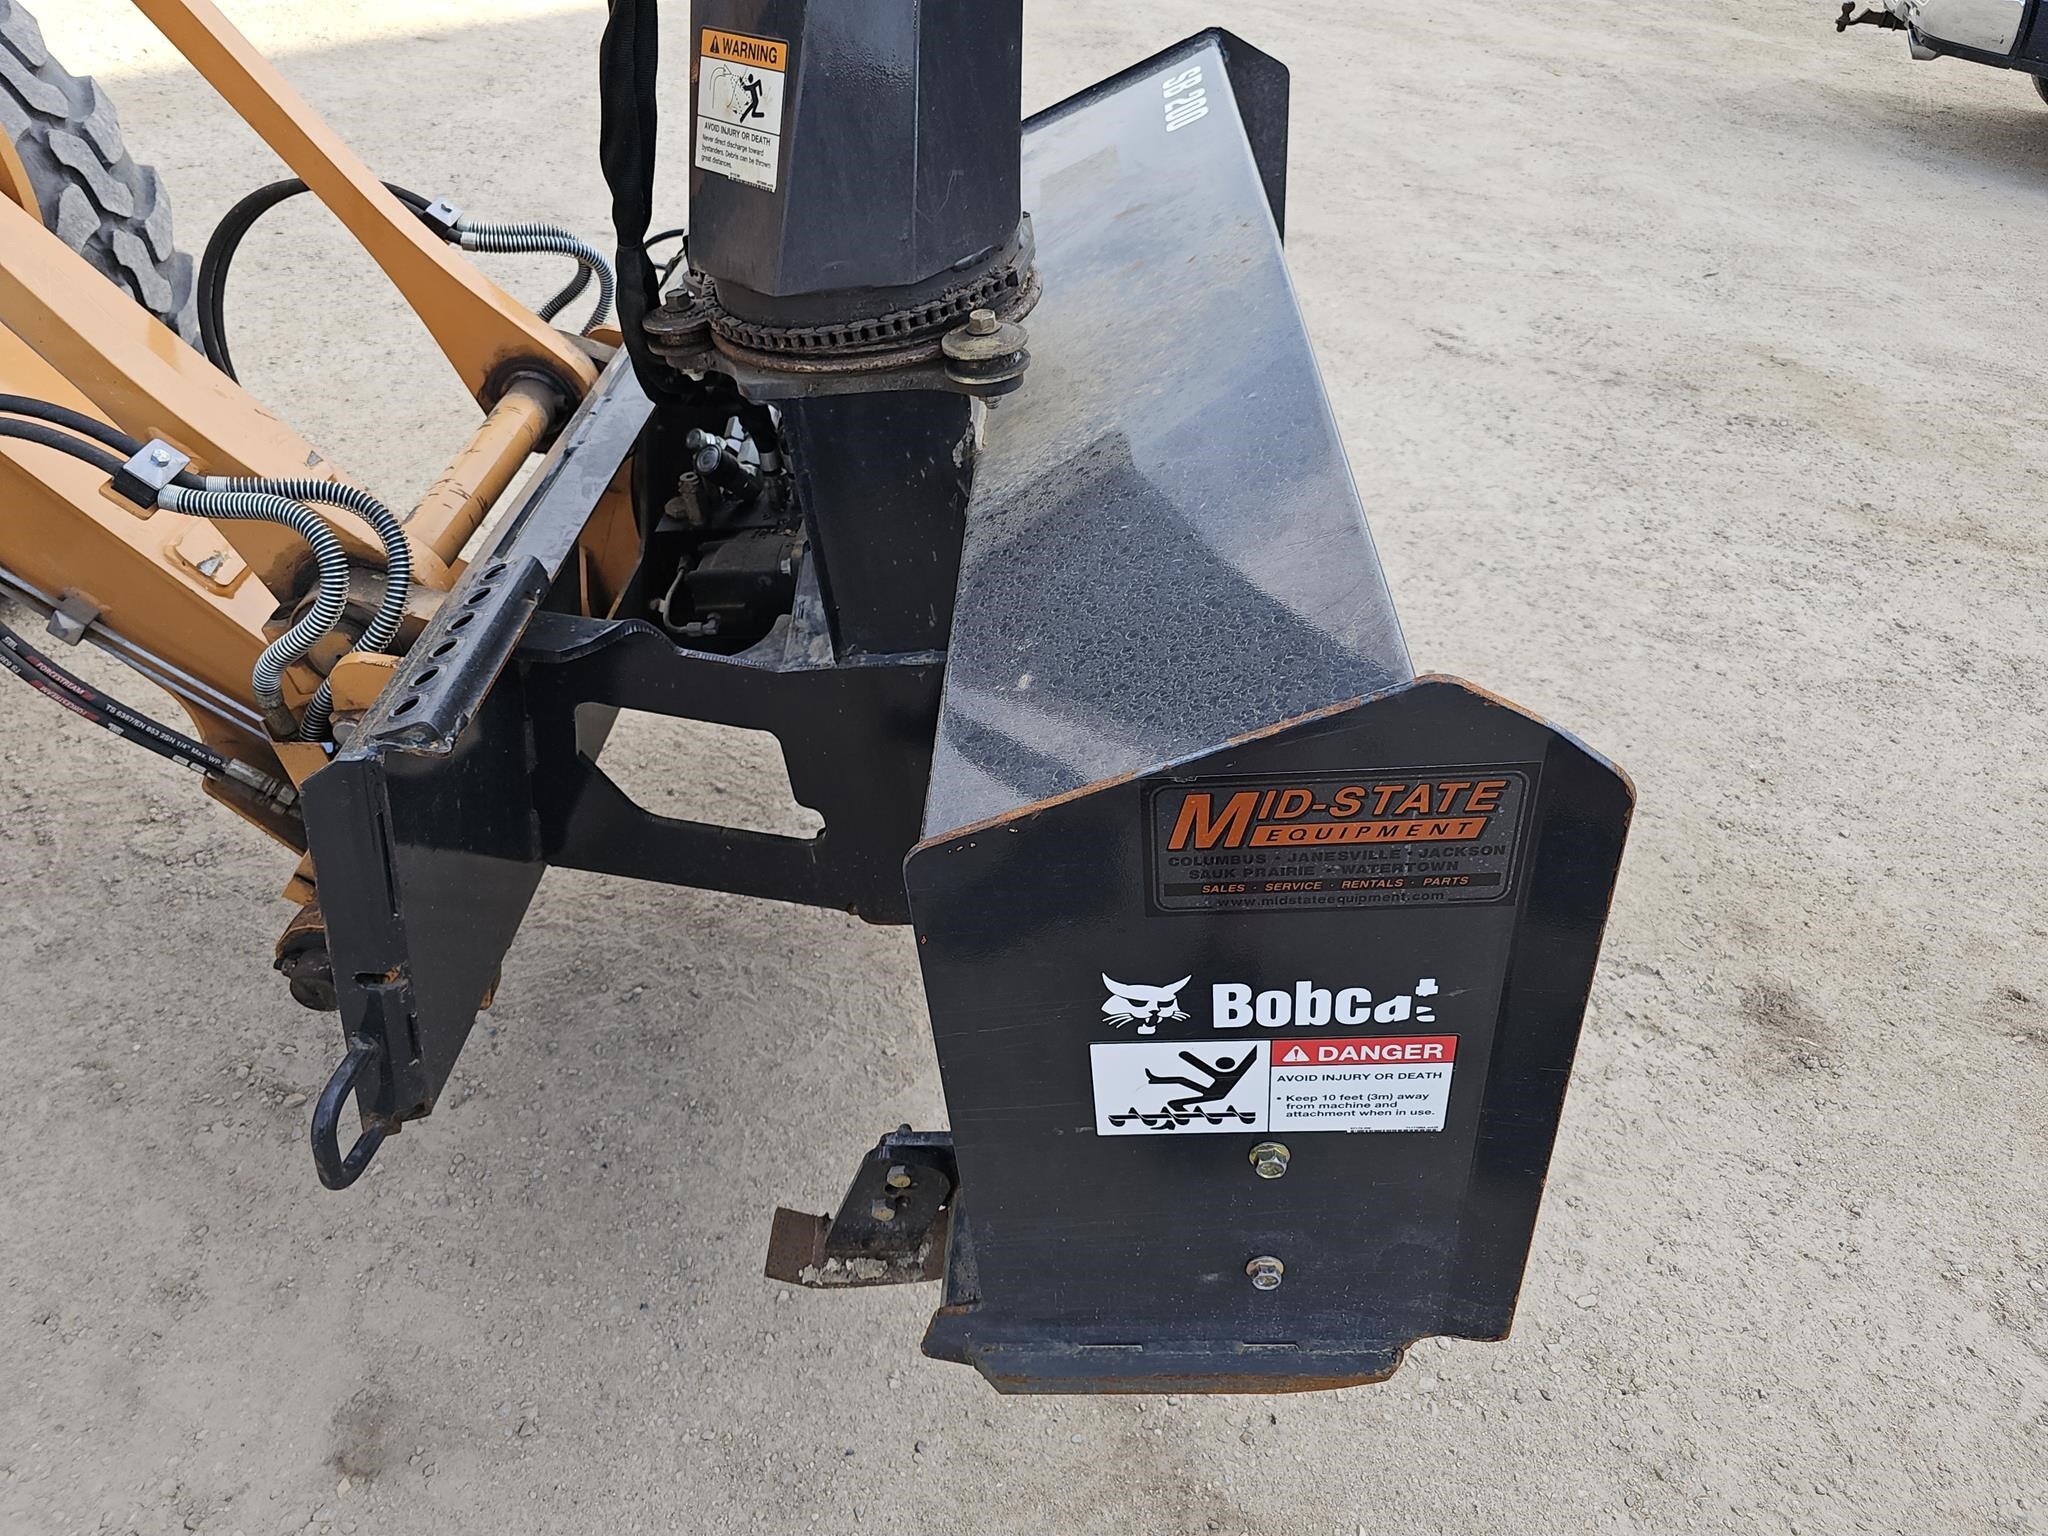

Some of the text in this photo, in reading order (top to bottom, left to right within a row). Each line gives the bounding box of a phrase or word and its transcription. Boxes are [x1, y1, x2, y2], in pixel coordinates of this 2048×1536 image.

[722, 37, 777, 64] WARNING
[1162, 66, 1209, 132] SB 200
[704, 122, 771, 146] AVOID INJURY OR DEATH
[702, 133, 764, 156] Never direct discharge toward
[701, 144, 725, 157] bystanders.
[725, 150, 739, 160] Debris
[748, 157, 755, 166] be
[755, 159, 771, 168] thrown
[701, 155, 712, 163] great
[36, 662, 86, 696] FORCESTREAM
[208, 756, 222, 765] WP
[1167, 780, 1507, 850] MID-STATE
[1265, 822, 1472, 842] EQUIPMENT
[1168, 845, 1506, 867] COLUMBUS JANESVILLE JACKSON
[1189, 861, 1459, 880] SAUK PRAIRIE WATERTOWN
[1202, 876, 1469, 894] SALES SERVICE RENTALS PARTS
[1217, 891, 1444, 907] www.midstateequipment.com
[1318, 1043, 1444, 1062] DANGER
[1276, 1072, 1442, 1082] AVOID INJURY OR DEATH
[1286, 1094, 1318, 1103] Keep
[1339, 1093, 1363, 1101] feet
[1367, 1093, 1394, 1102] (3m)
[1397, 1093, 1430, 1101] away
[1286, 1102, 1316, 1110] from
[1318, 1101, 1371, 1109] machine
[1285, 1109, 1356, 1118] attachment
[1359, 1109, 1392, 1117] when
